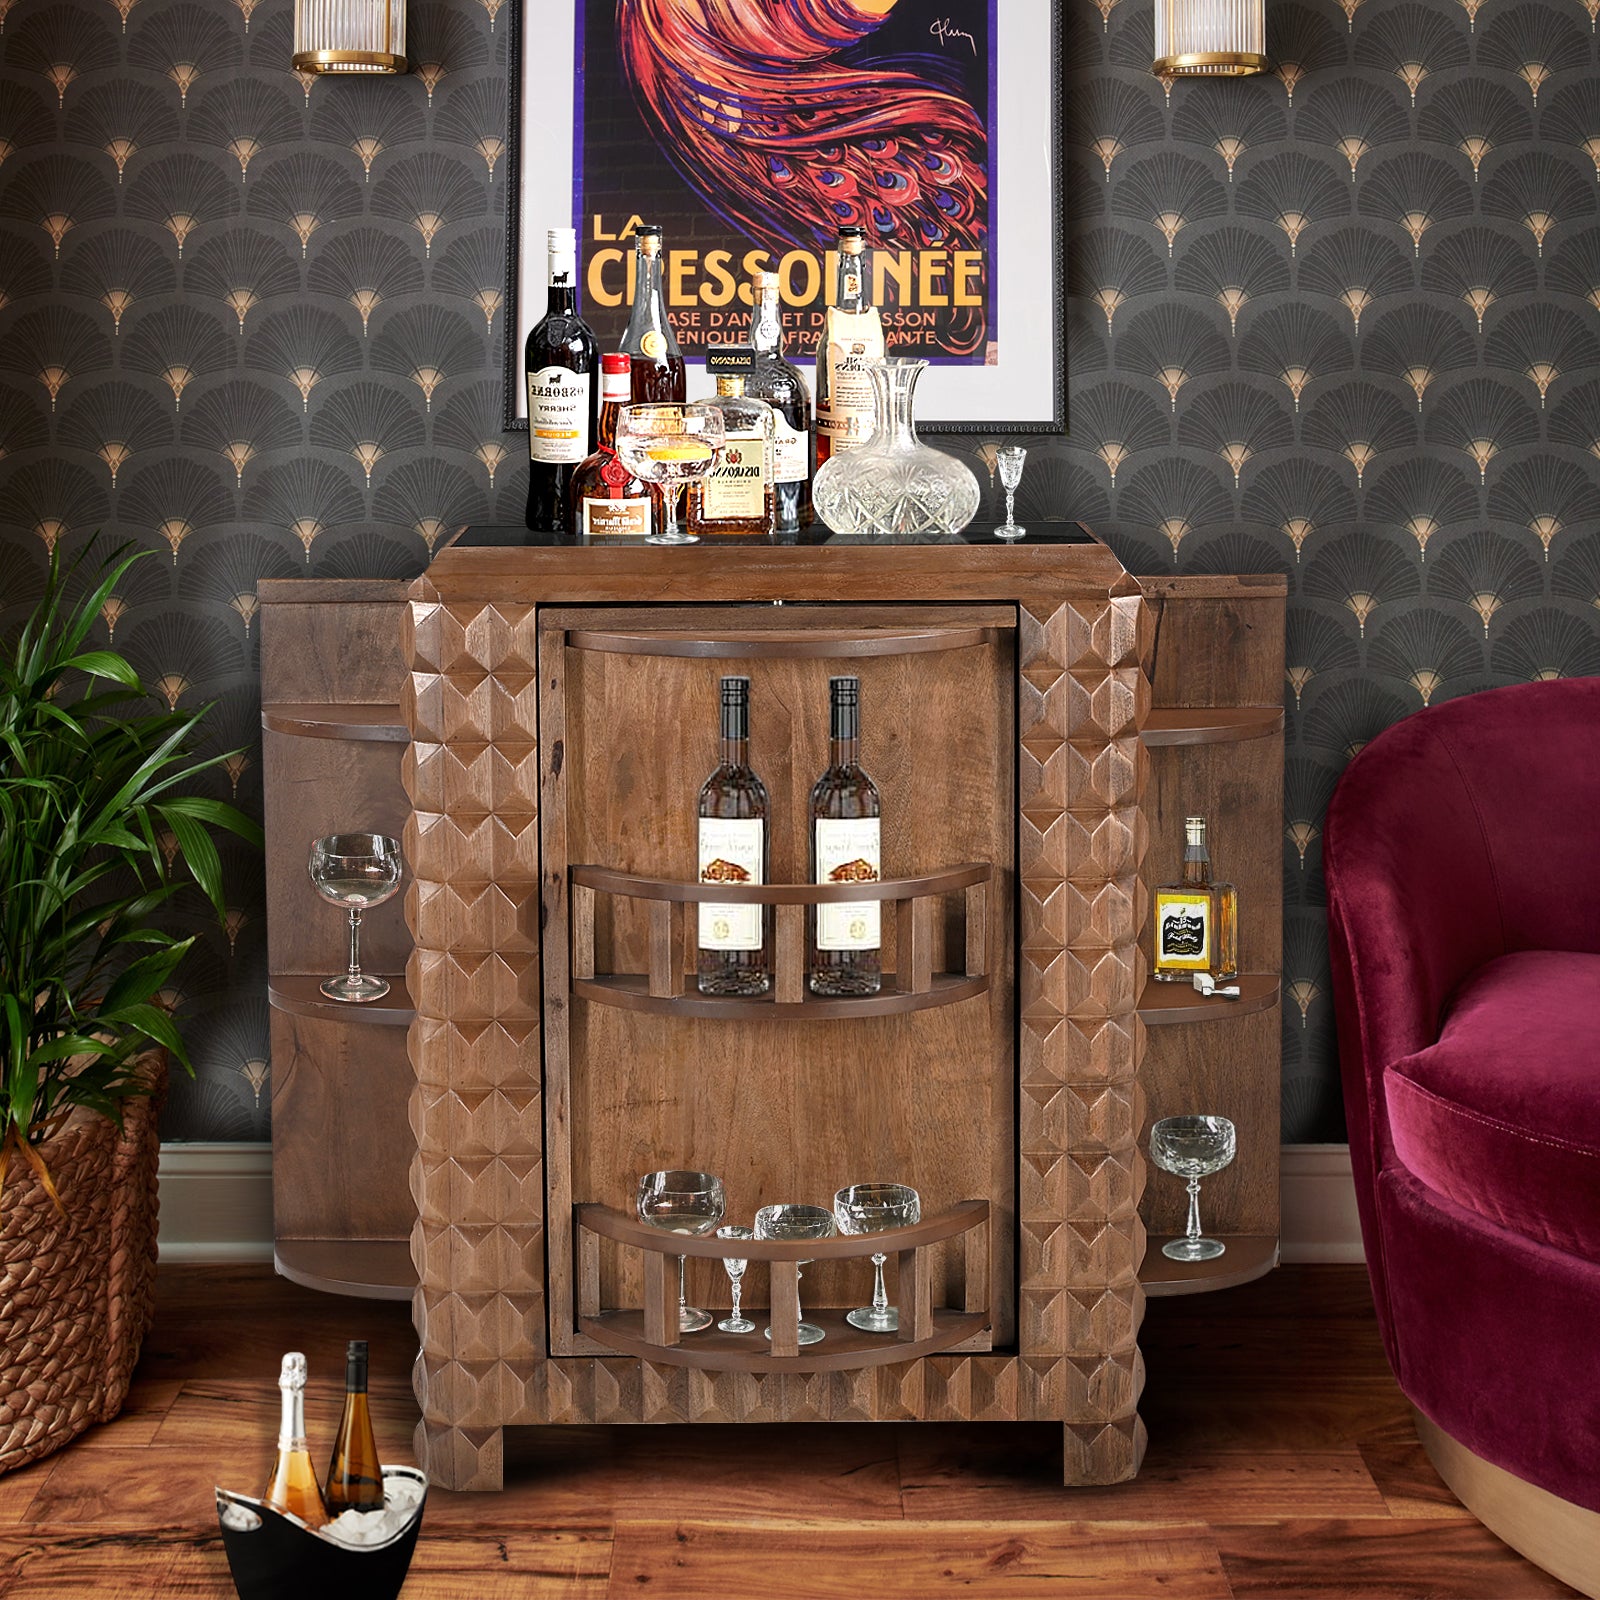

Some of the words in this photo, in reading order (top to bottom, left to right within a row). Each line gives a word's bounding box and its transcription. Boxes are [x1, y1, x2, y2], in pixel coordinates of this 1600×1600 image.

[593, 214, 645, 241] LA
[587, 241, 983, 307] CESSONÉE
[667, 312, 701, 327] ASE
[710, 312, 754, 327] D'AN
[782, 313, 804, 327] ET
[811, 312, 825, 327] D
[676, 328, 748, 345] ÉNIQUE
